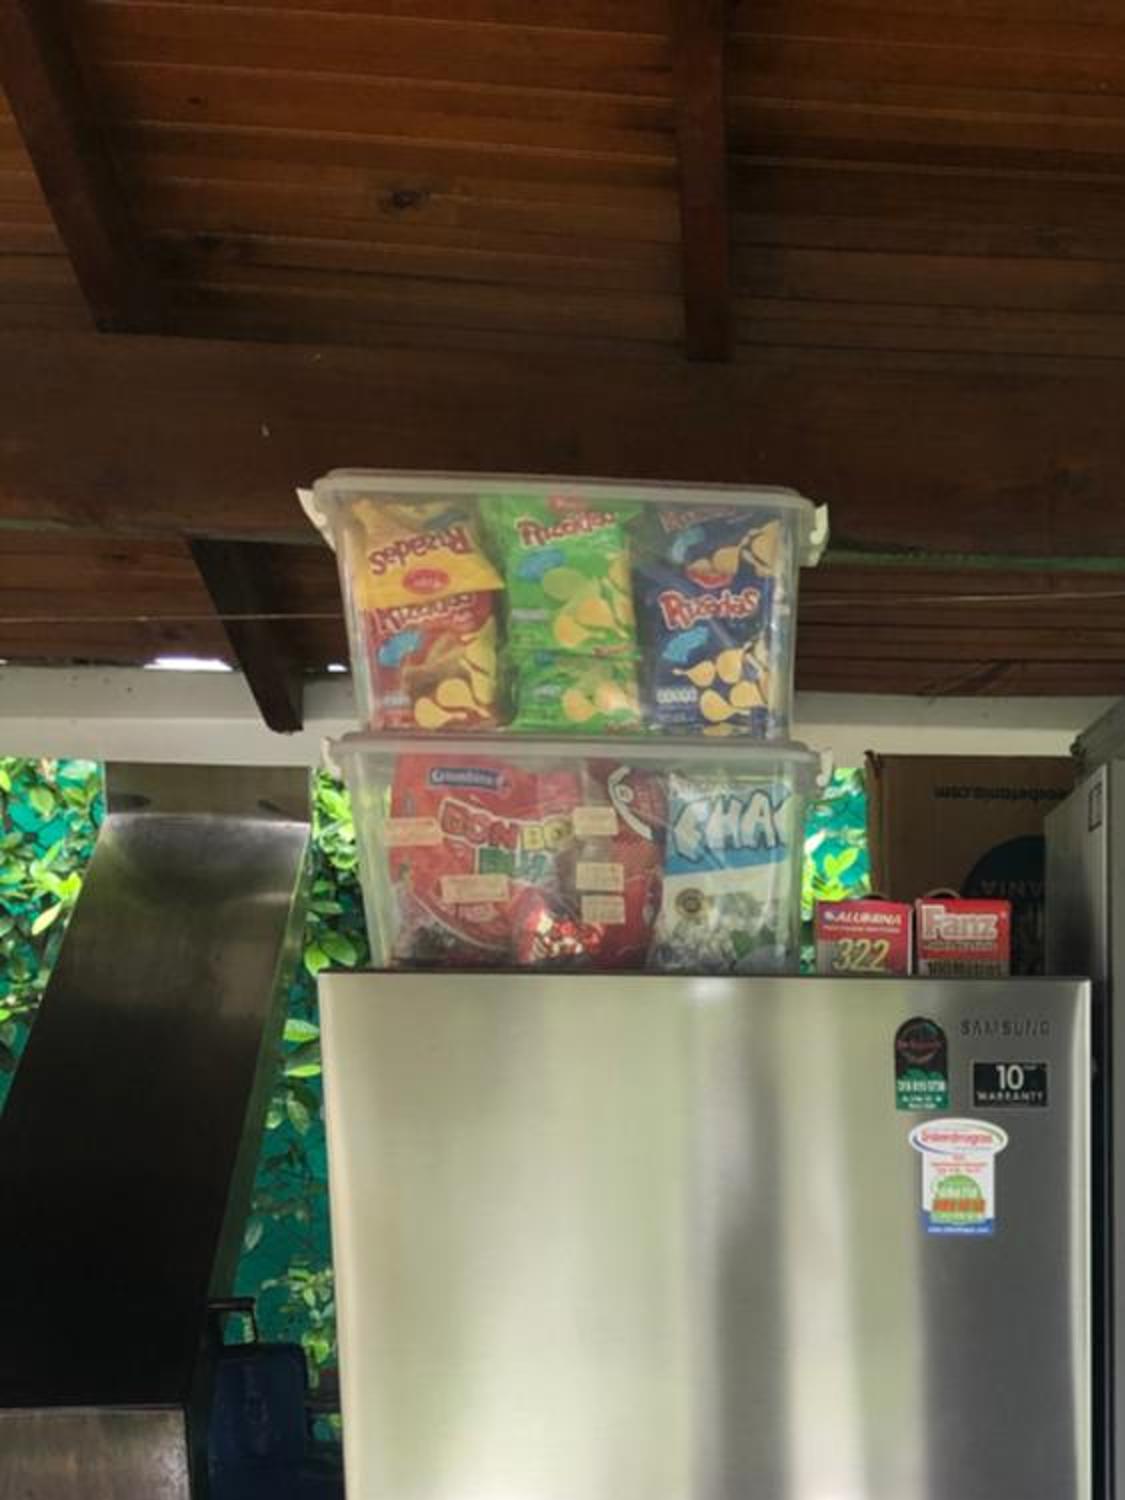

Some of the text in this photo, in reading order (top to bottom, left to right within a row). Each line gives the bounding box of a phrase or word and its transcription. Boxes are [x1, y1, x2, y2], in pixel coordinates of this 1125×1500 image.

[833, 939, 890, 974] 322
[960, 1020, 1050, 1036] SAMSUNG
[996, 1064, 1024, 1090] 10
[976, 1090, 1043, 1102] WARRANTY
